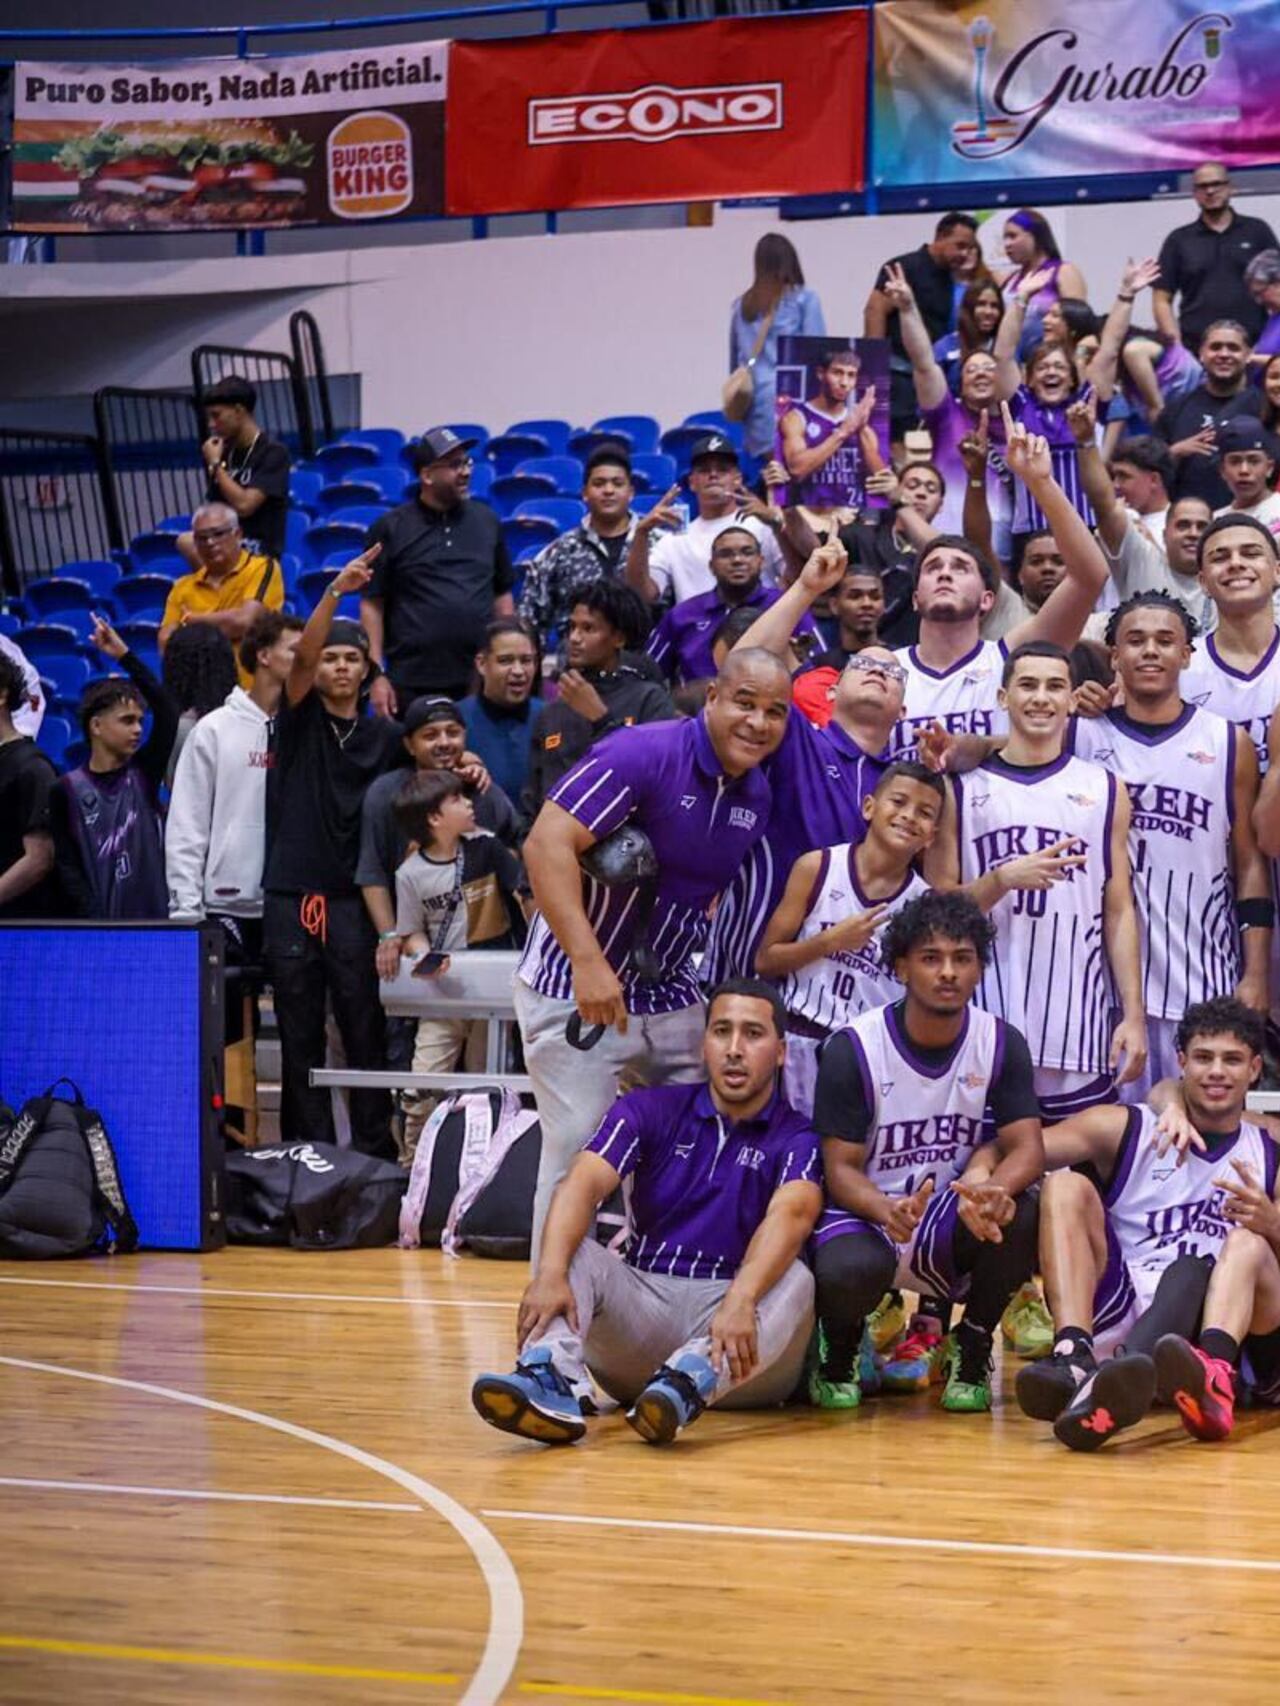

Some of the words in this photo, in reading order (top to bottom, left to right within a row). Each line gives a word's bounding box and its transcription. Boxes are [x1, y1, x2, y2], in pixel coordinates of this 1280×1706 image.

[25, 76, 105, 104] Puro
[110, 75, 213, 107] Sabor,
[219, 74, 296, 101] Nada
[301, 57, 443, 95] Artificial.
[953, 14, 1232, 159] Gurabo
[536, 89, 775, 134] ECONO
[331, 143, 407, 168] BURGER
[332, 164, 409, 196] KING
[1124, 781, 1214, 832] REH
[831, 970, 855, 1001] 10
[864, 1113, 982, 1172] JIREH
